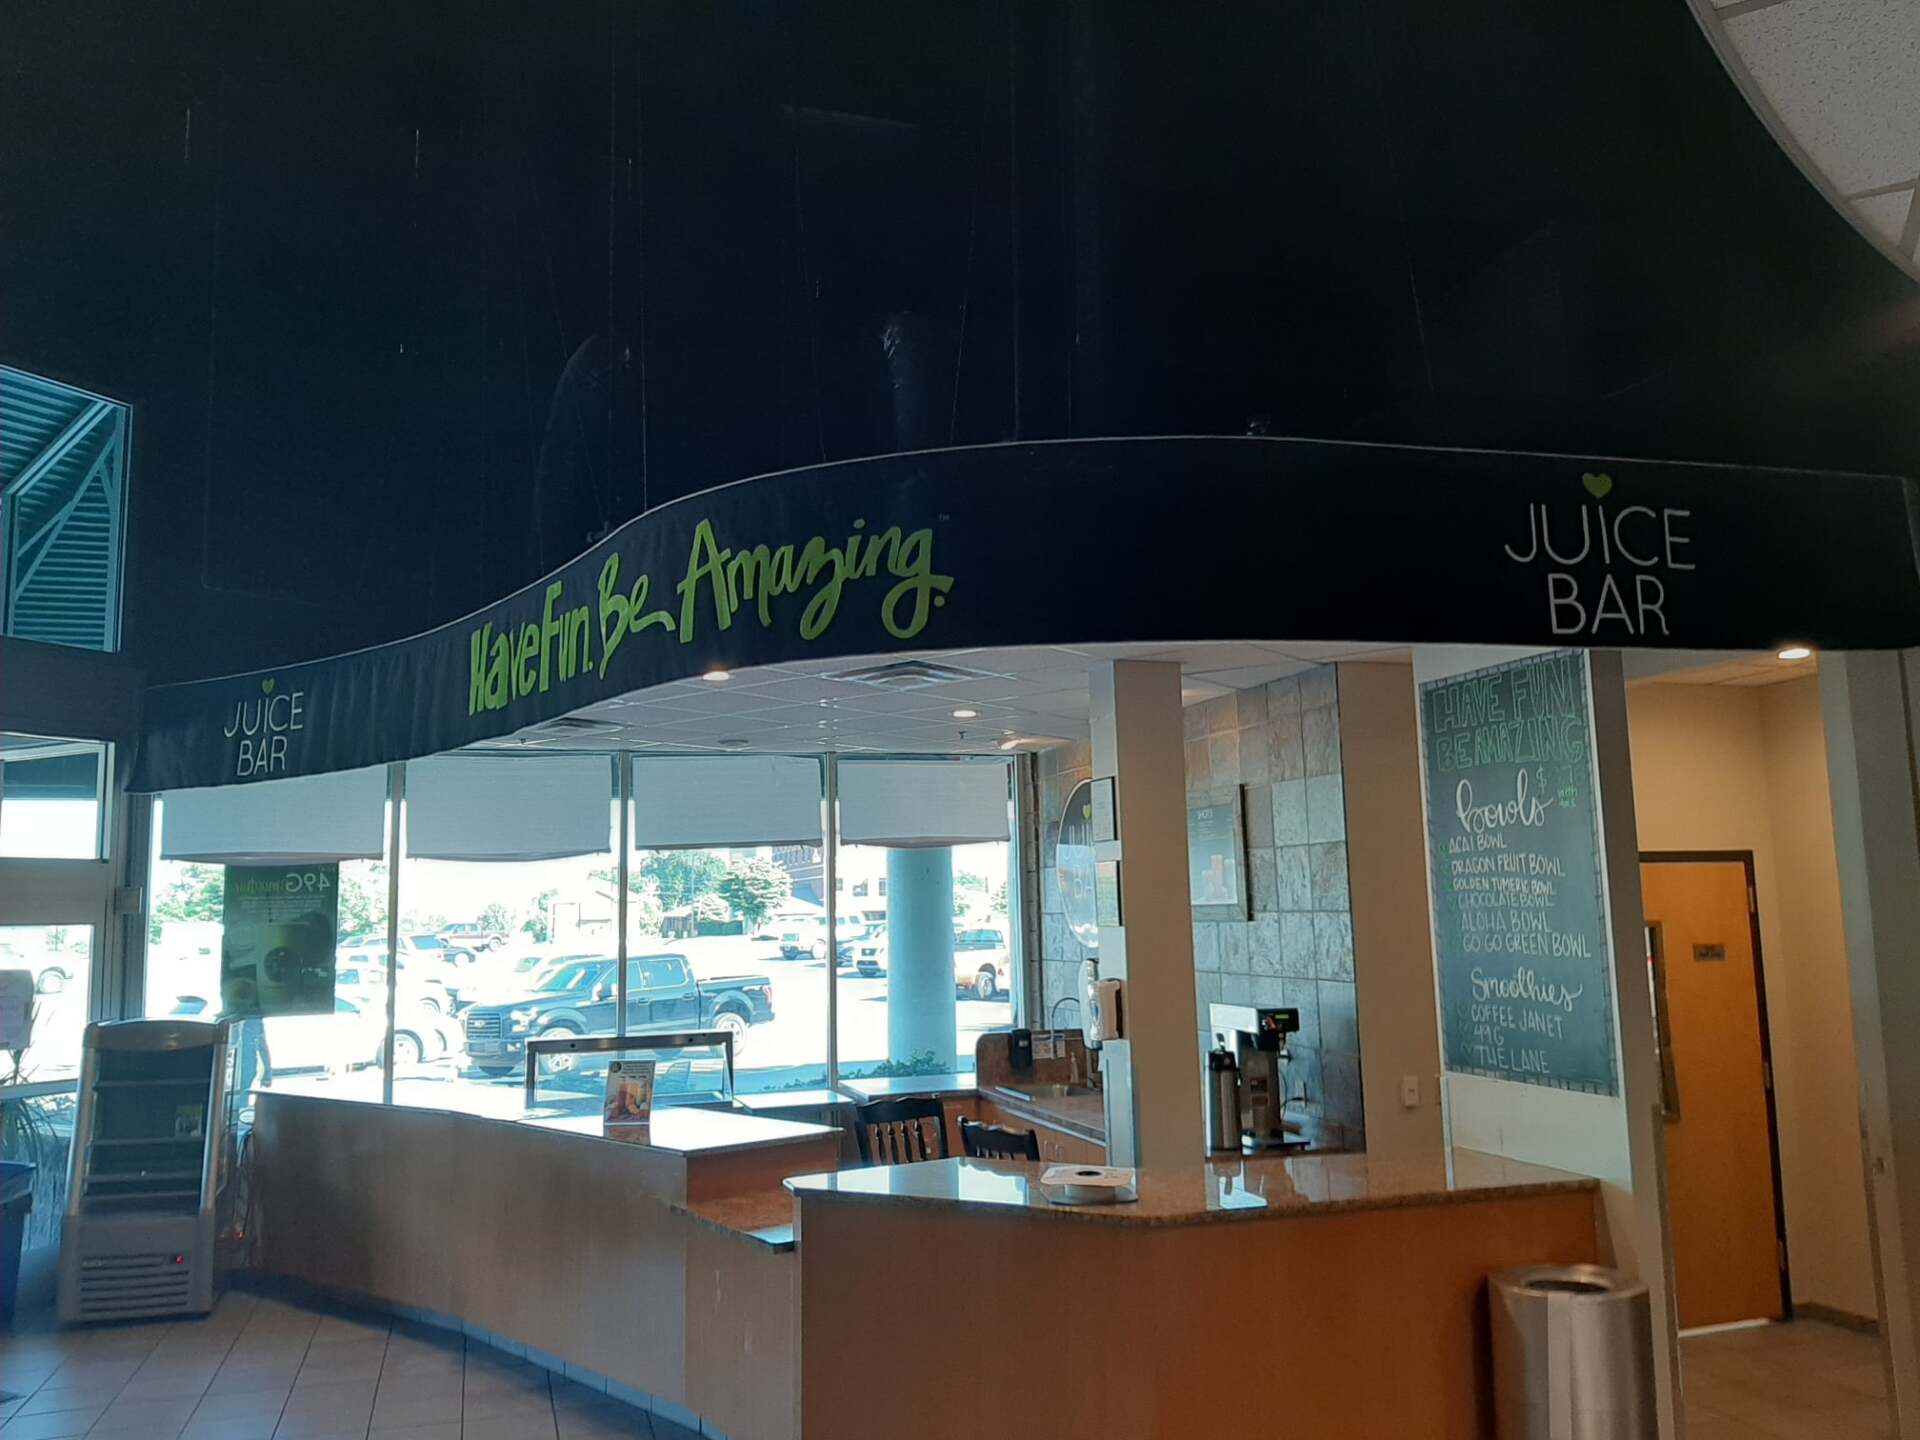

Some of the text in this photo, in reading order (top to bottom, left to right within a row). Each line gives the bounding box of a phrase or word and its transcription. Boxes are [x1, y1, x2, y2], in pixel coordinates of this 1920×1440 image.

[1504, 503, 1696, 569] JUICE
[1548, 573, 1669, 635] BAR
[469, 622, 539, 716] Have
[598, 552, 676, 680] Be
[1433, 658, 1577, 733] HAVE FUN
[224, 692, 304, 737] JUICE
[237, 736, 288, 776] BAR
[1456, 768, 1553, 833] bowls
[1449, 832, 1507, 853] ACAI BOWL
[1451, 853, 1566, 877] DRAGON FRUIT BOWL
[1453, 877, 1489, 891] GOLDEN
[1531, 880, 1556, 895] BOWL
[1458, 891, 1556, 909] CHOCOLATE BOWL
[1461, 909, 1552, 932] ALOHA BOWL
[1505, 932, 1549, 956] GREEN
[1551, 932, 1591, 958] BOWL
[1471, 966, 1583, 1012] Smoothies
[1471, 1004, 1563, 1039] COFFEE JANET
[1474, 1023, 1504, 1046] 49G
[1474, 1044, 1551, 1074] THE LANE
